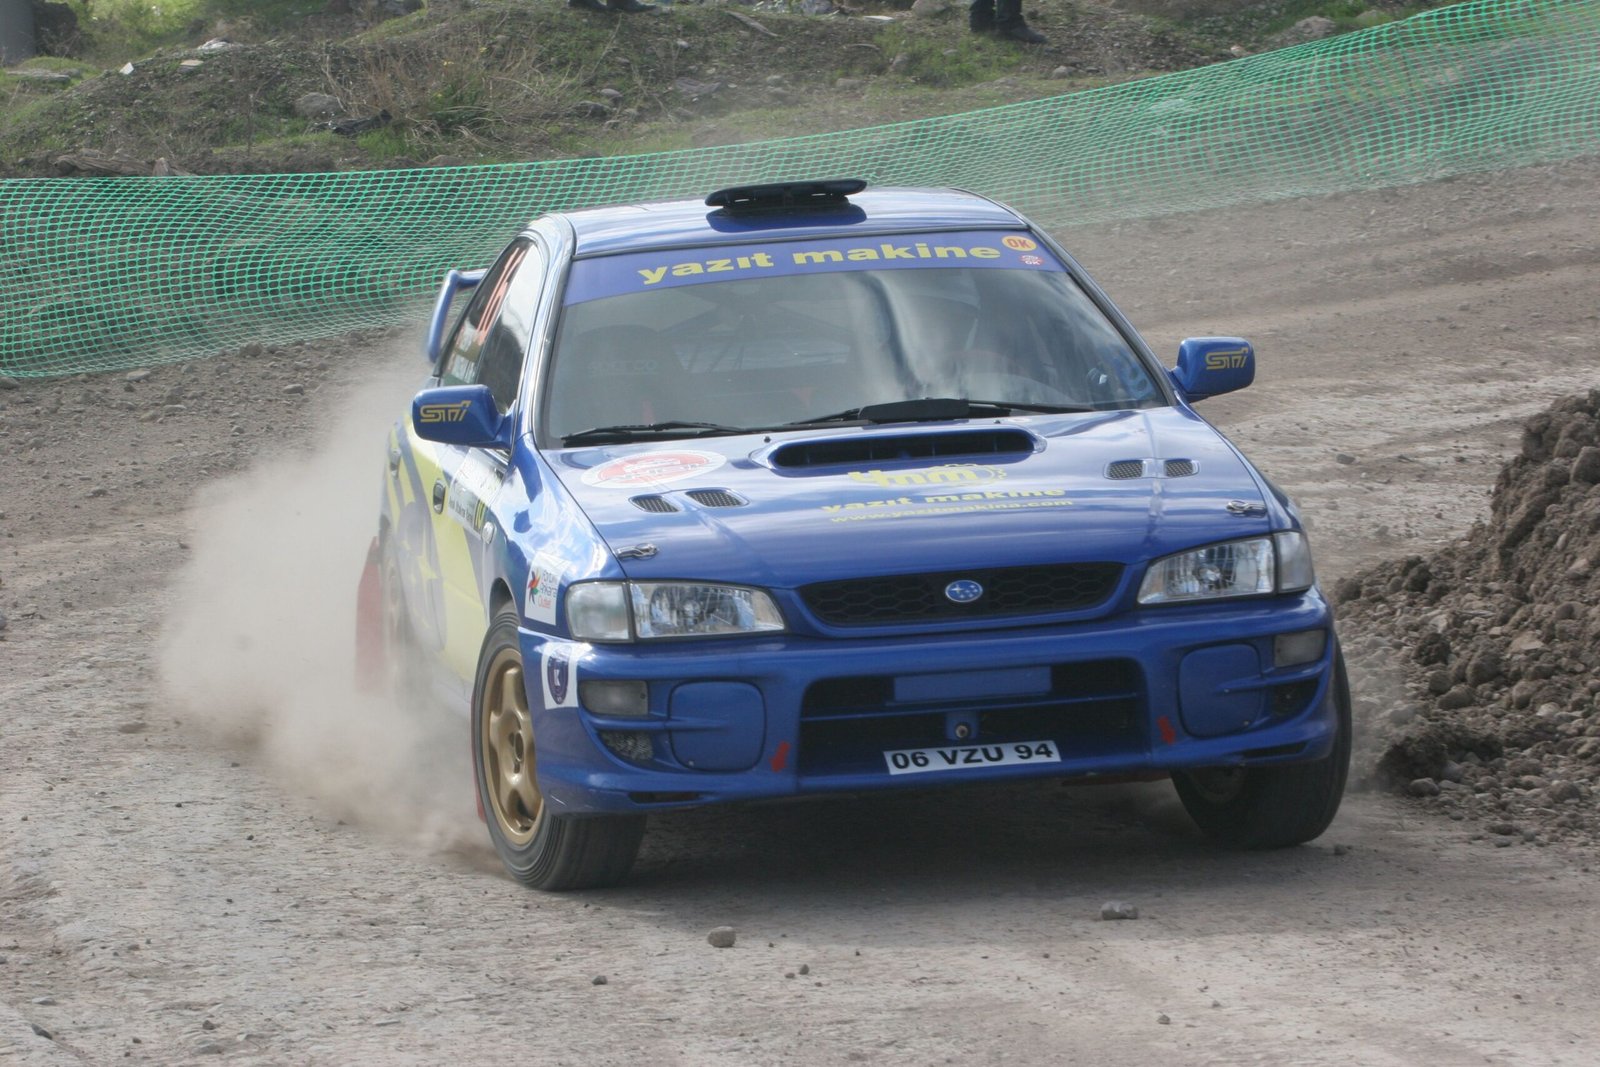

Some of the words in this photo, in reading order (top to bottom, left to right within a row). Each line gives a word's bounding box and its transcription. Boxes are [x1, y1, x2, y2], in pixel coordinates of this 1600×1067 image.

[1006, 238, 1032, 249] OK
[792, 242, 1001, 265] makine
[924, 488, 1066, 504] makine
[891, 750, 930, 770] 06
[937, 746, 1004, 766] VZU
[1014, 743, 1054, 761] 94
